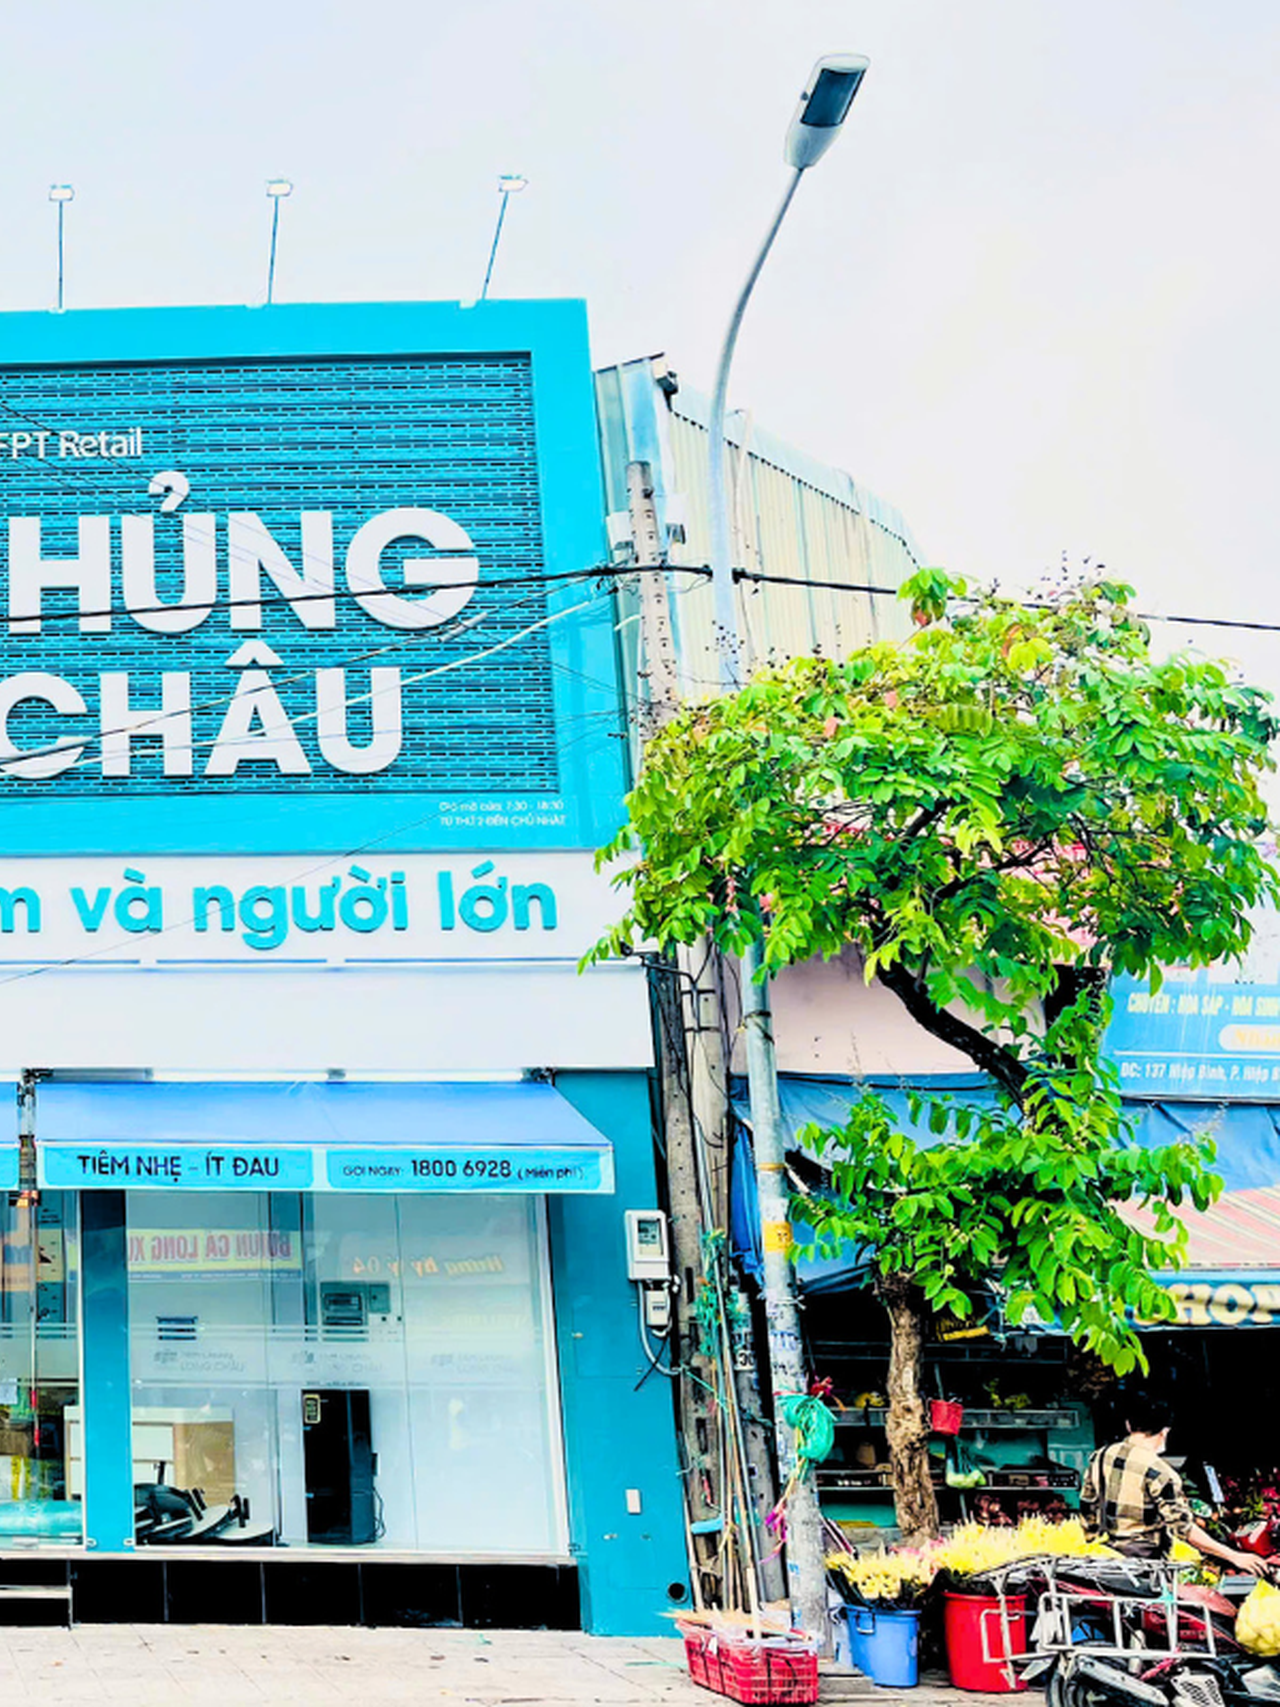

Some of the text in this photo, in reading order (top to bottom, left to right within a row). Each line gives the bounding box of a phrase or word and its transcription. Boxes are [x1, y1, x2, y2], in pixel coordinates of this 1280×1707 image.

[59, 427, 143, 459] Retail
[70, 866, 163, 935] và
[193, 863, 409, 951] người
[438, 859, 558, 934] lớn
[1145, 1063, 1166, 1078] 137
[77, 1150, 129, 1176] TIÊM
[137, 1156, 182, 1183] NHẸ
[206, 1151, 225, 1177] ÍT
[232, 1156, 280, 1177] ĐAU
[412, 1160, 457, 1177] 1800
[463, 1160, 512, 1178] 6928
